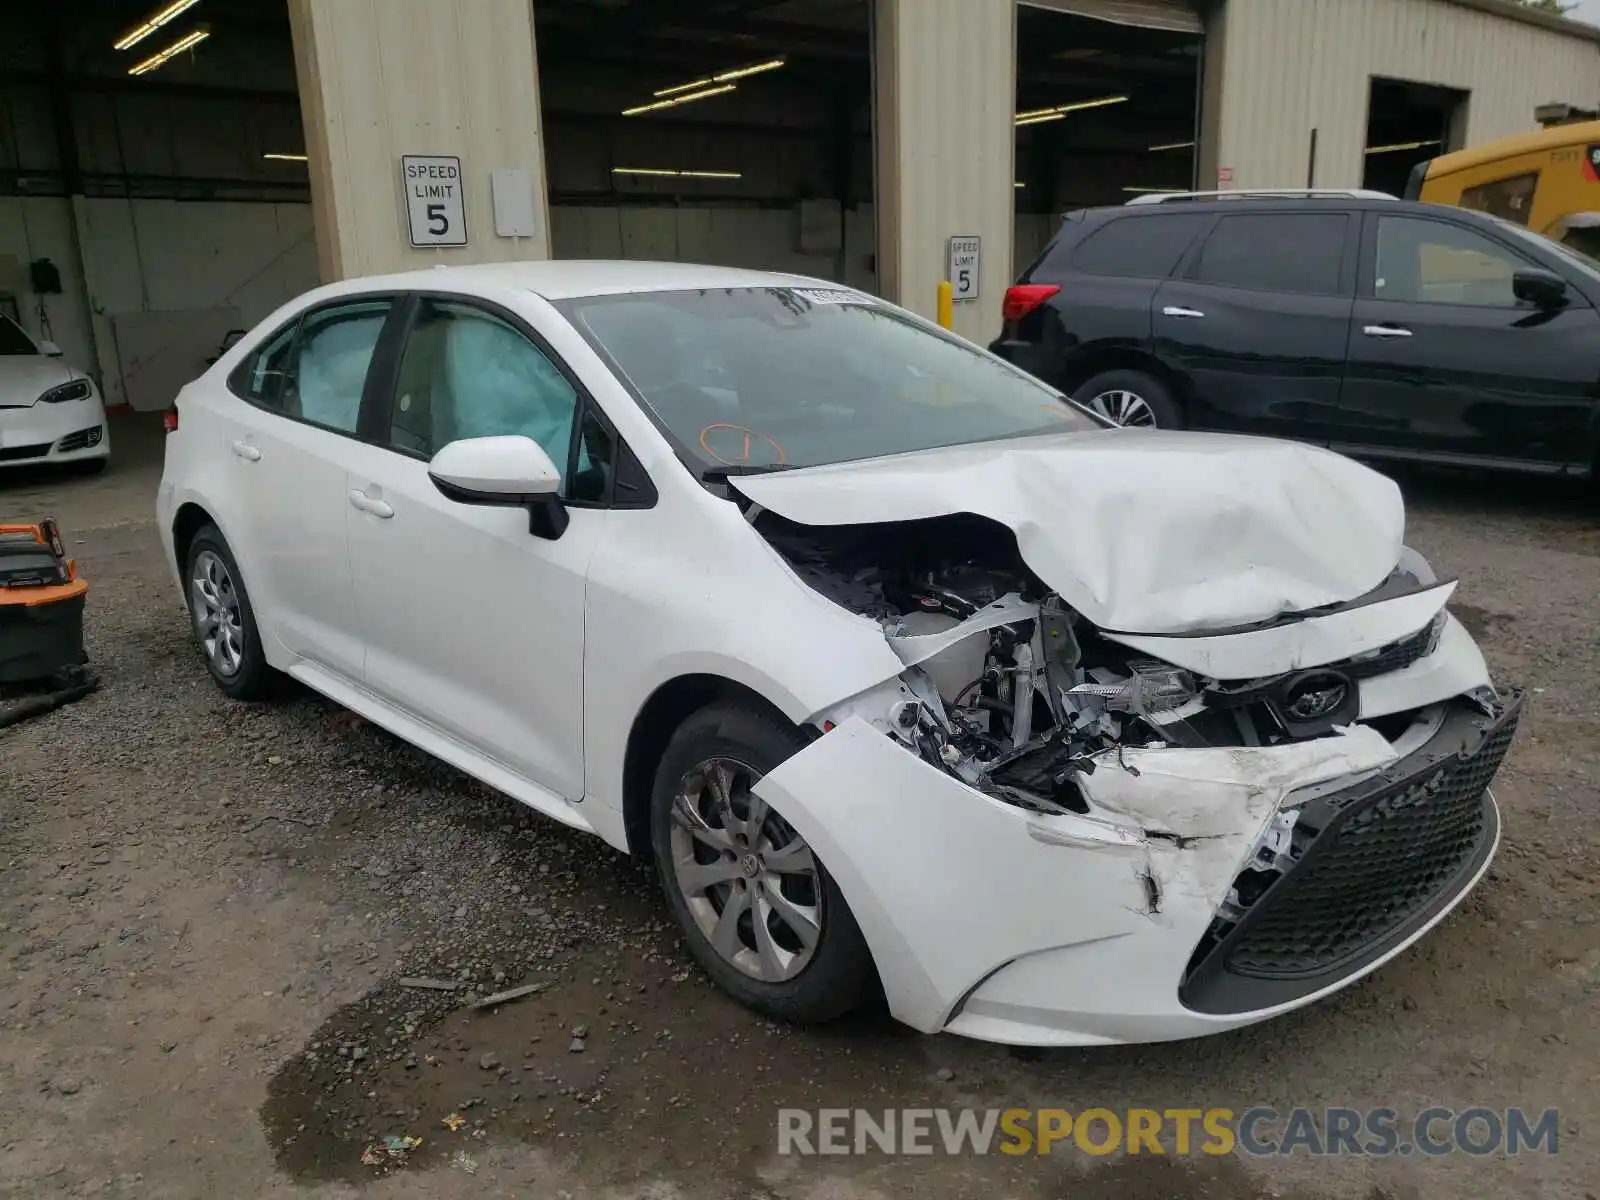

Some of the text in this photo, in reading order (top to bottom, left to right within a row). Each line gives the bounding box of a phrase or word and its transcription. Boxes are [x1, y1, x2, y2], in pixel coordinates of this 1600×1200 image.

[407, 165, 457, 179] SPEED
[415, 185, 453, 198] LIMIT
[426, 203, 449, 236] 5
[952, 242, 978, 253] SPEED
[954, 256, 975, 266] LIMIT
[959, 269, 971, 293] 5
